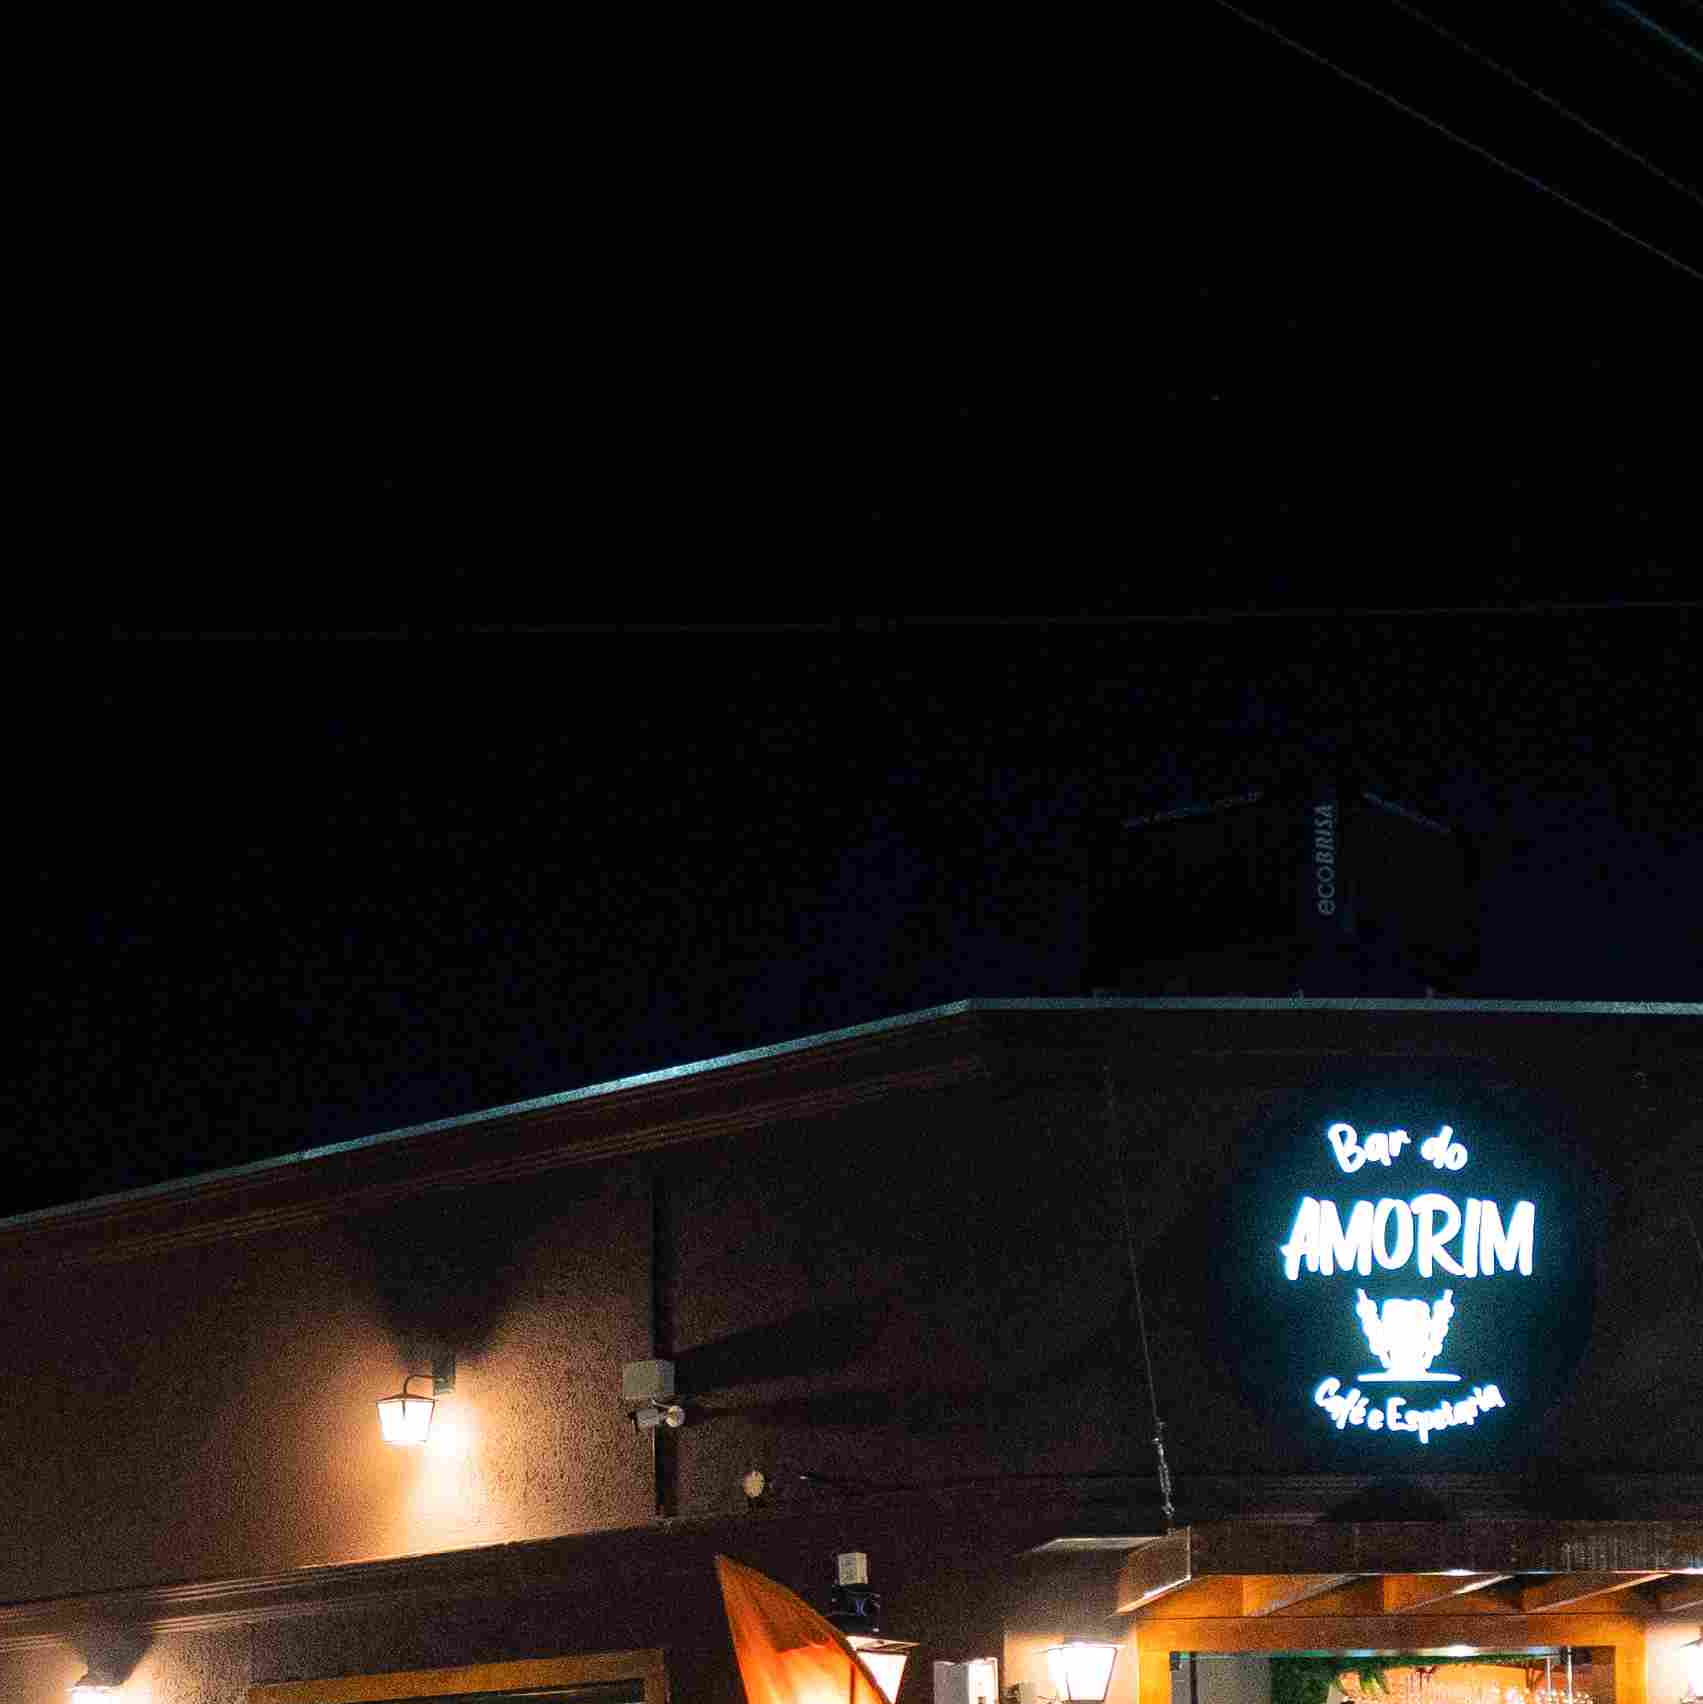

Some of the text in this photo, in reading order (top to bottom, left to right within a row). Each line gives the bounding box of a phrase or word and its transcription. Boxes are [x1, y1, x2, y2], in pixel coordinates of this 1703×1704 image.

[1327, 1123, 1468, 1173] Bar do
[1279, 1192, 1536, 1280] AMORIM
